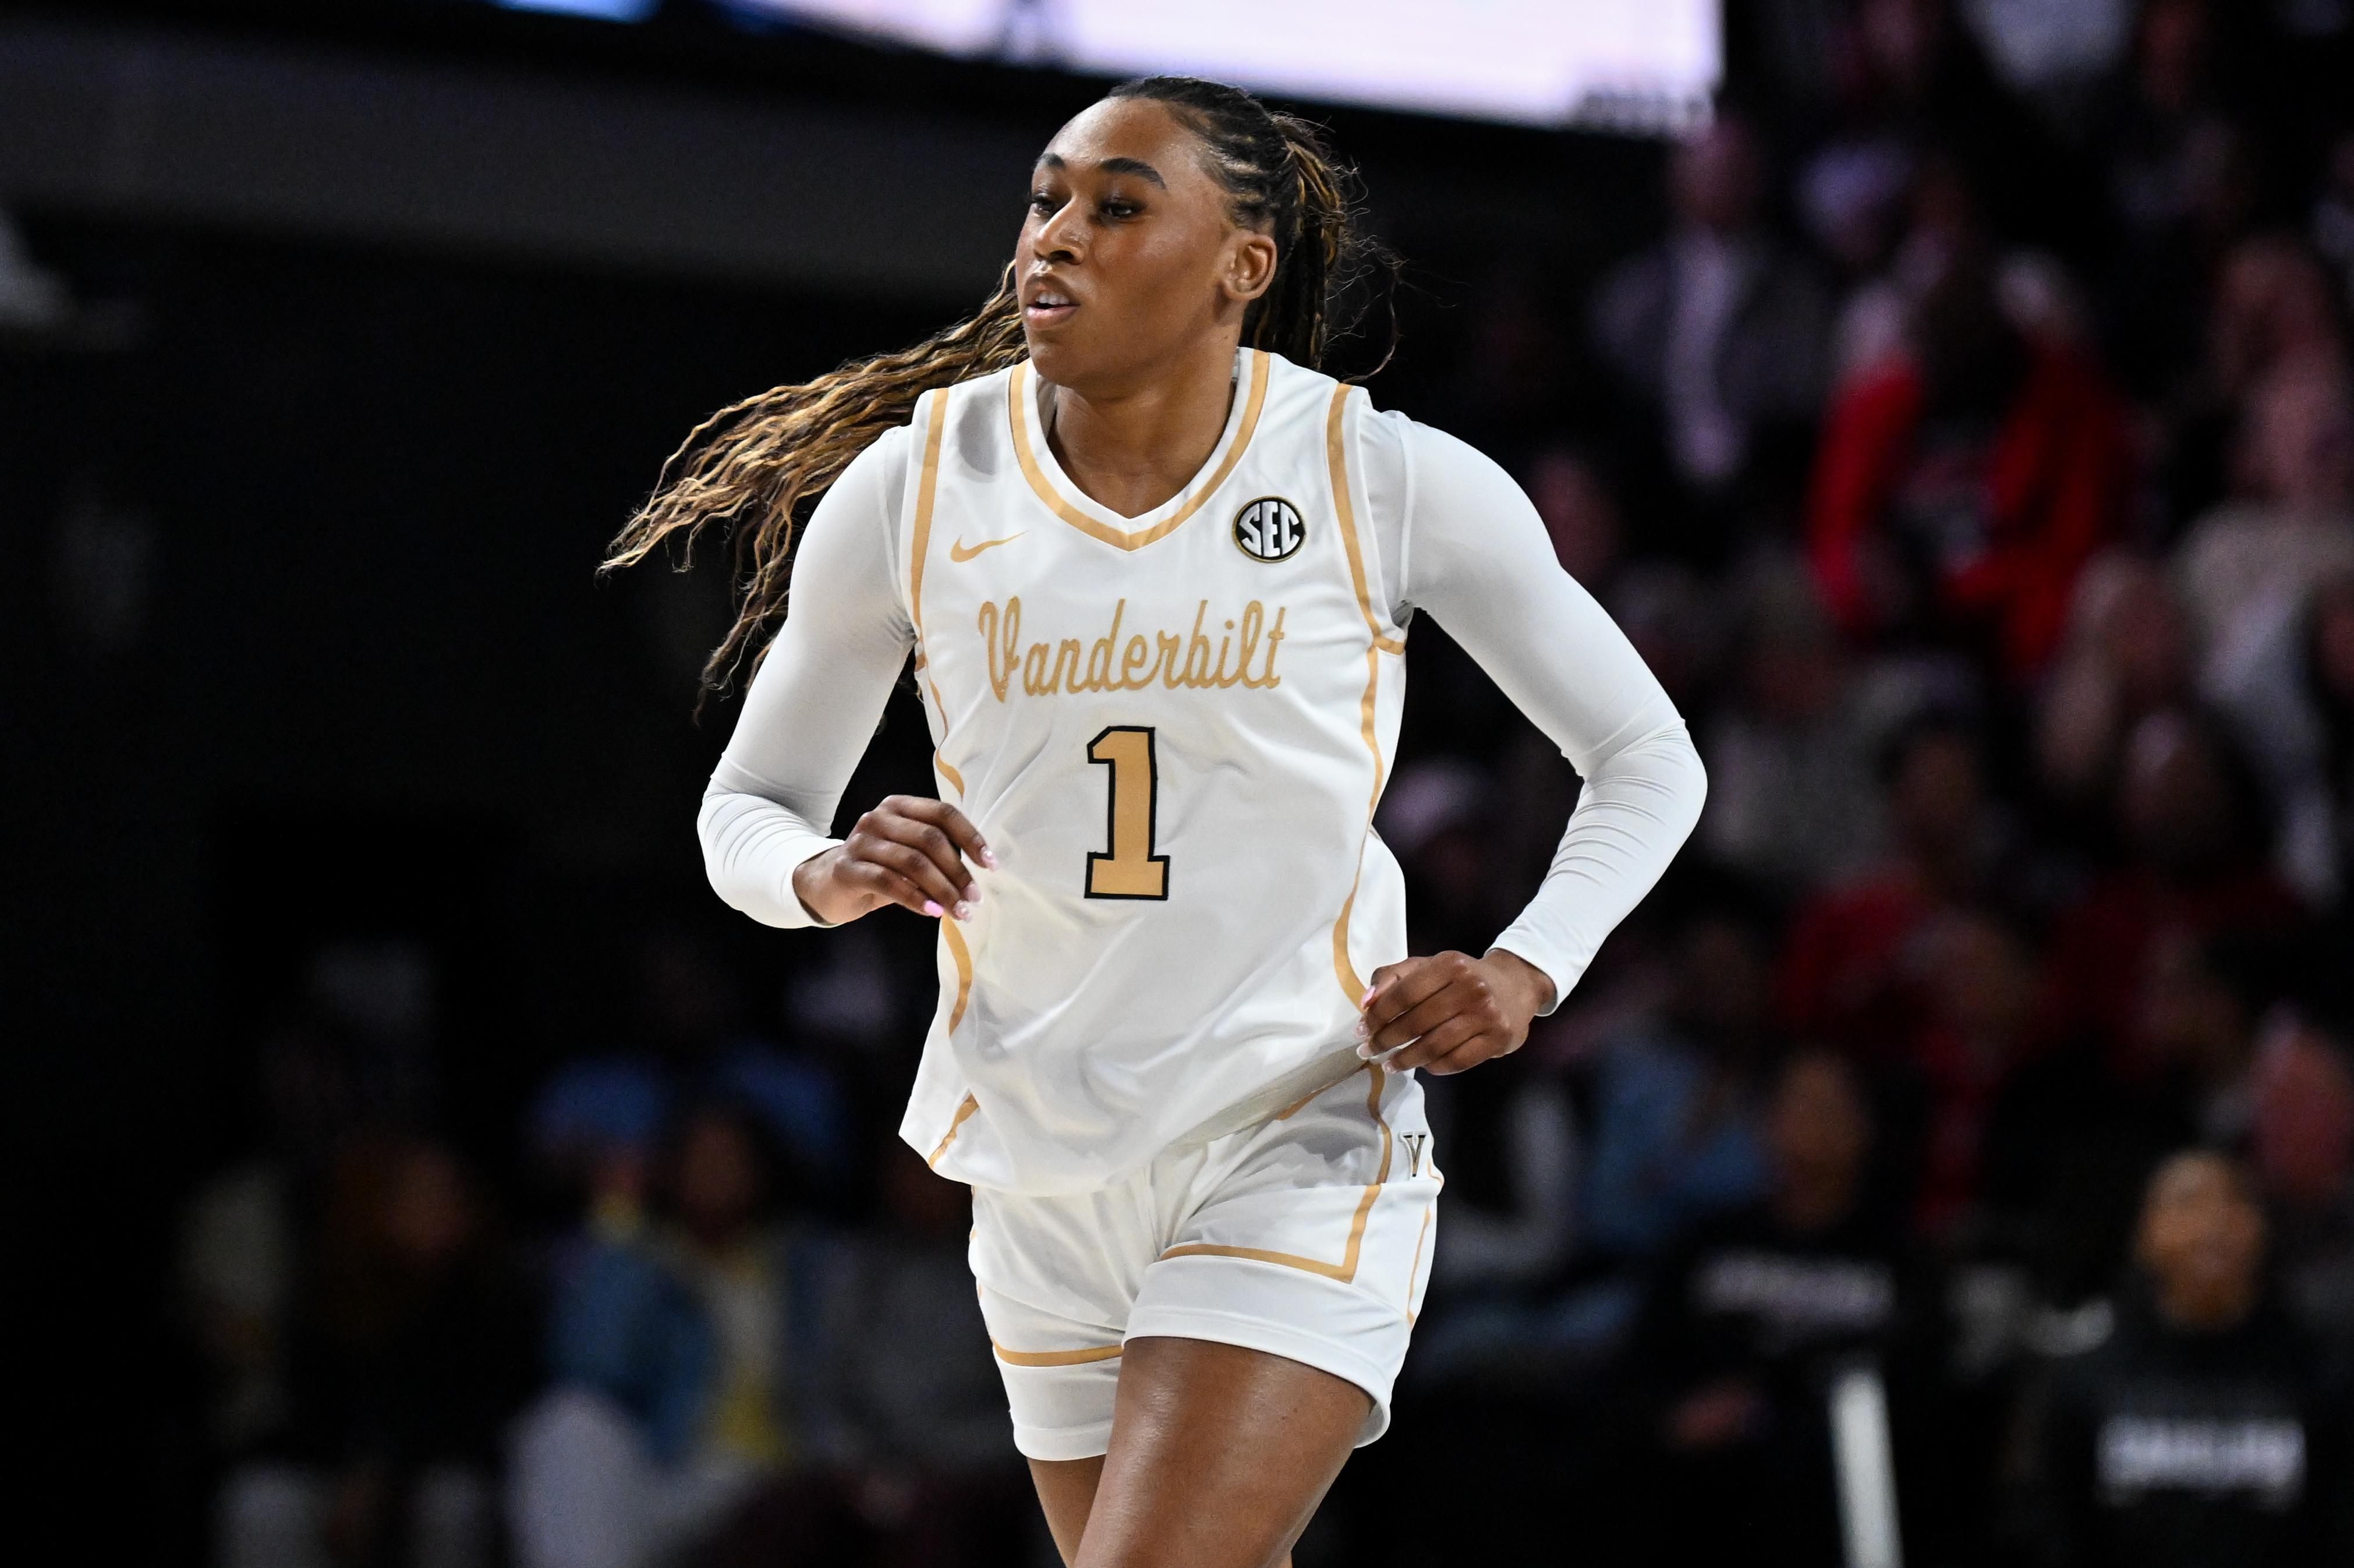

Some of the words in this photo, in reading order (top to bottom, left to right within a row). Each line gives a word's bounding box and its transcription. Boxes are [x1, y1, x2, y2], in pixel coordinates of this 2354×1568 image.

[1238, 501, 1301, 557] SEC
[978, 596, 1285, 703] Vanderbilt
[1084, 725, 1170, 900] 1
[1401, 1132, 1426, 1177] V
